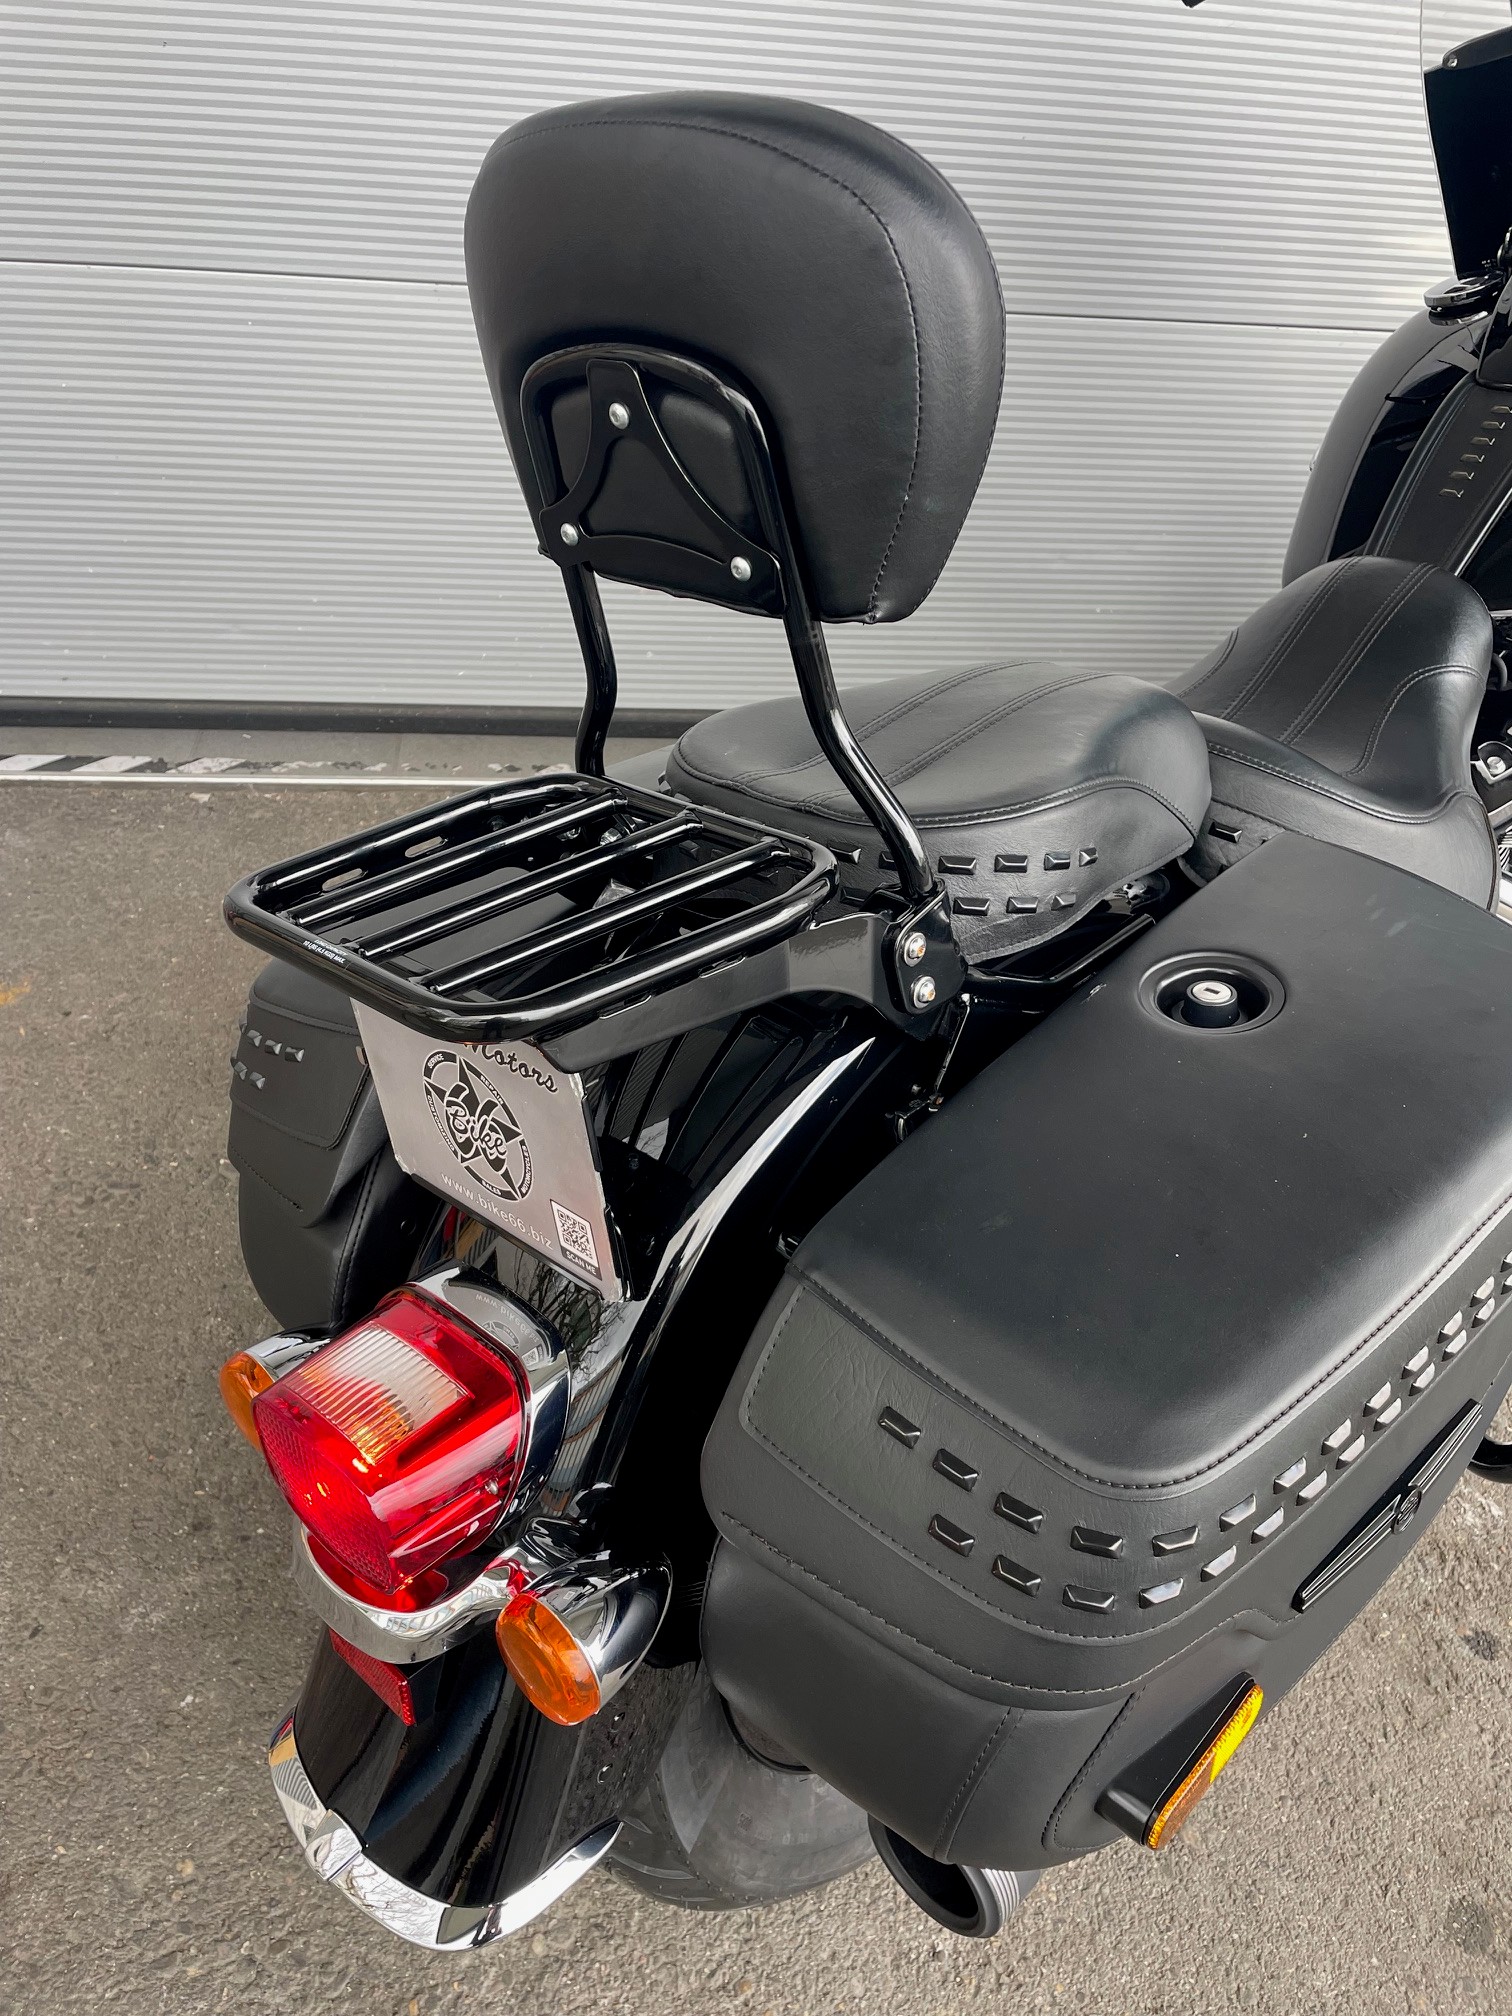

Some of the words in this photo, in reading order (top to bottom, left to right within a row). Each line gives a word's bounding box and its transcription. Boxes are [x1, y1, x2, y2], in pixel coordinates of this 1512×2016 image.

[427, 1053, 445, 1069] SERVICE
[479, 1074, 504, 1105] REPAIR
[445, 1099, 508, 1157] Bike
[520, 1145, 533, 1195] MOTORCYCLES
[481, 1179, 502, 1196] SALES
[441, 1173, 553, 1251] www.bike66.biz
[566, 1250, 585, 1268] SCAN
[585, 1263, 597, 1276] ME
